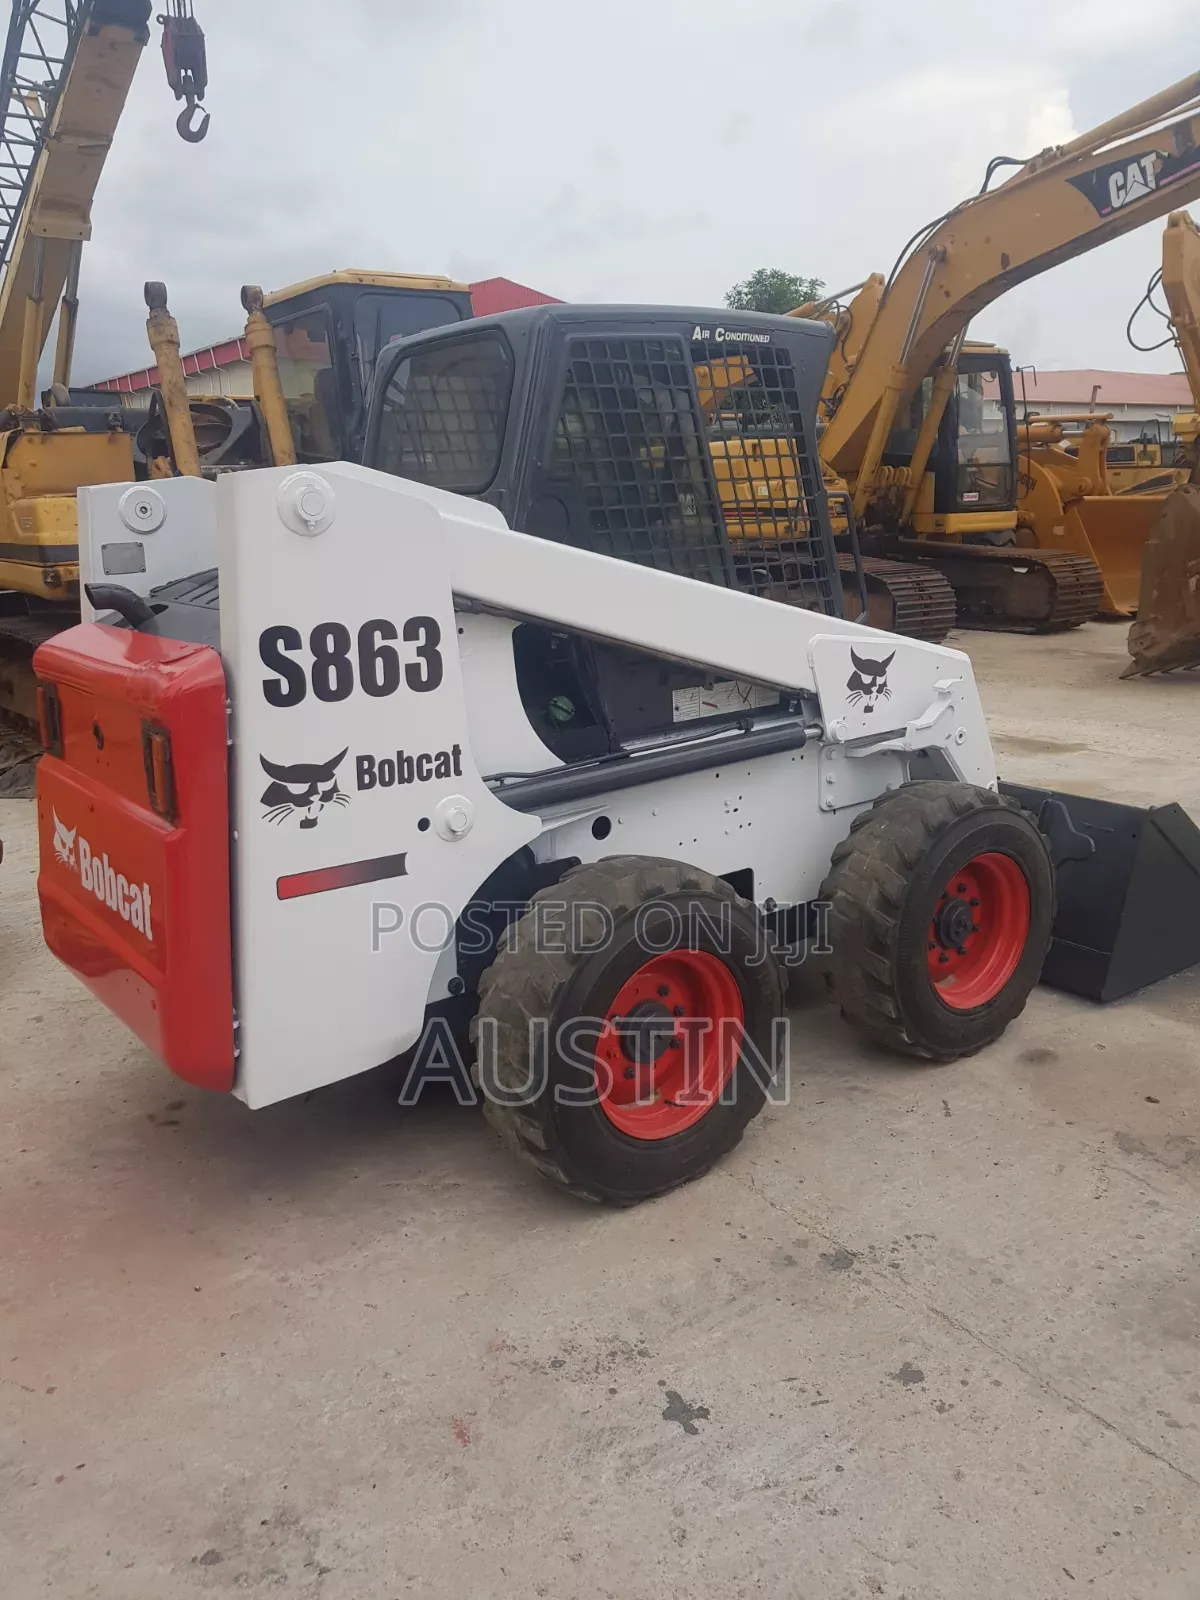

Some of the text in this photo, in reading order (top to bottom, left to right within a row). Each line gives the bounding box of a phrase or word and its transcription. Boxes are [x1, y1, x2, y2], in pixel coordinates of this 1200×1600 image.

[1108, 151, 1158, 208] CAT
[692, 326, 770, 343] AIR CONDITIONED
[259, 615, 443, 708] S863
[355, 743, 463, 791] Bobcat
[78, 835, 153, 941] Bobcat
